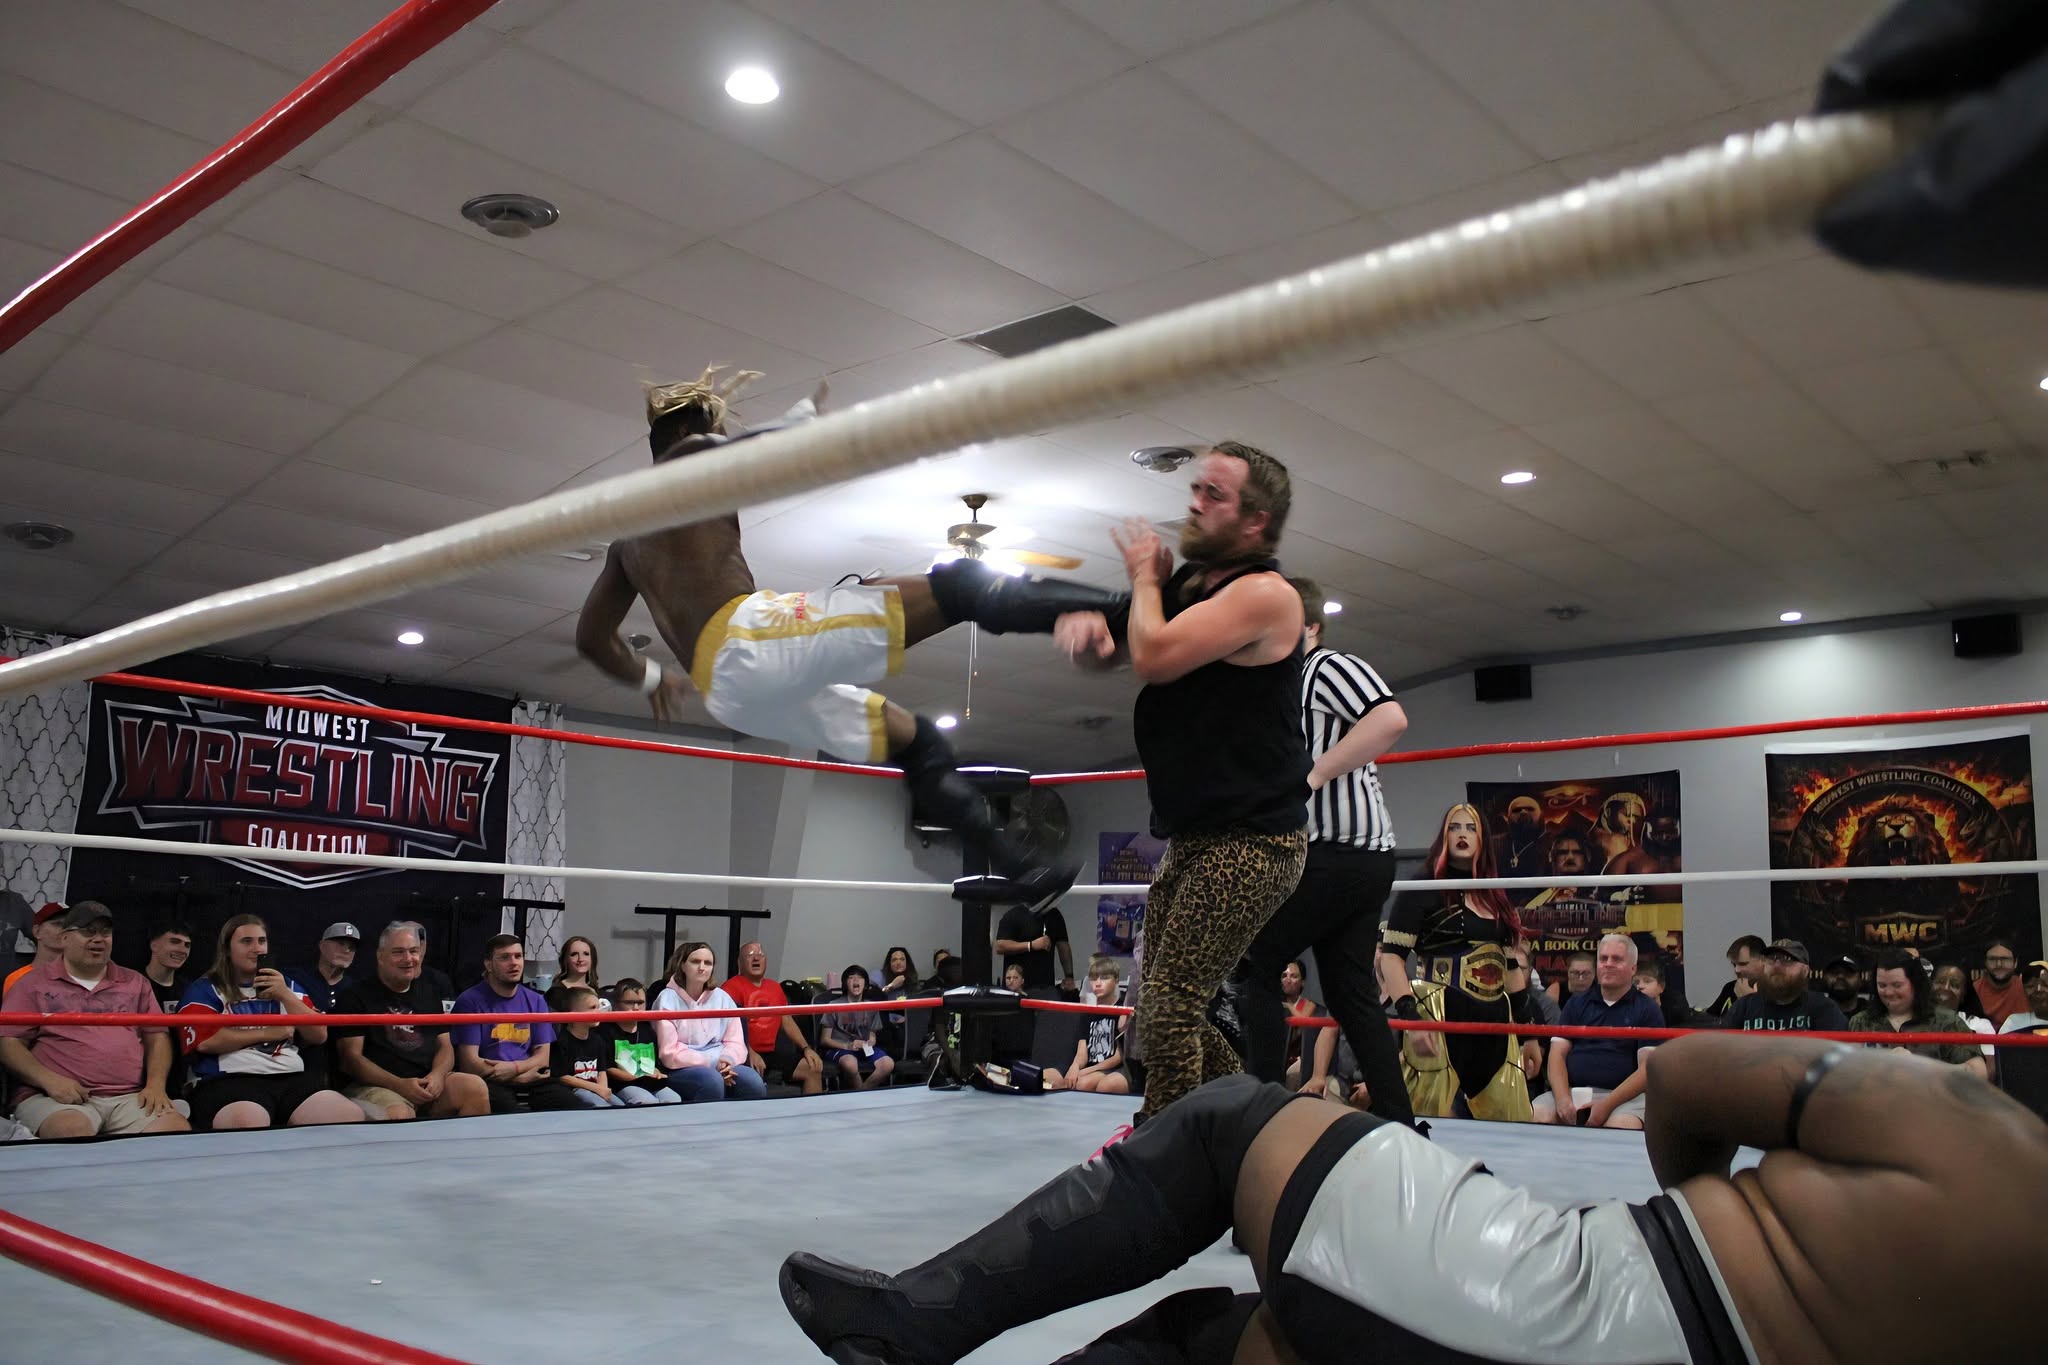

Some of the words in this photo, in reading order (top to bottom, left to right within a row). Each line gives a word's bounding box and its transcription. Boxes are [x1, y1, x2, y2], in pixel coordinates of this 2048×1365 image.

[264, 704, 370, 744] MIDWEST
[118, 715, 484, 835] WRESTLING
[1813, 780, 1855, 814] MIDWEST
[1856, 771, 1921, 787] WRESTLING
[1923, 774, 1978, 806] COALITION
[247, 823, 368, 855] COALITION
[1544, 940, 1580, 951] BOOK
[1863, 922, 1938, 944] MWC
